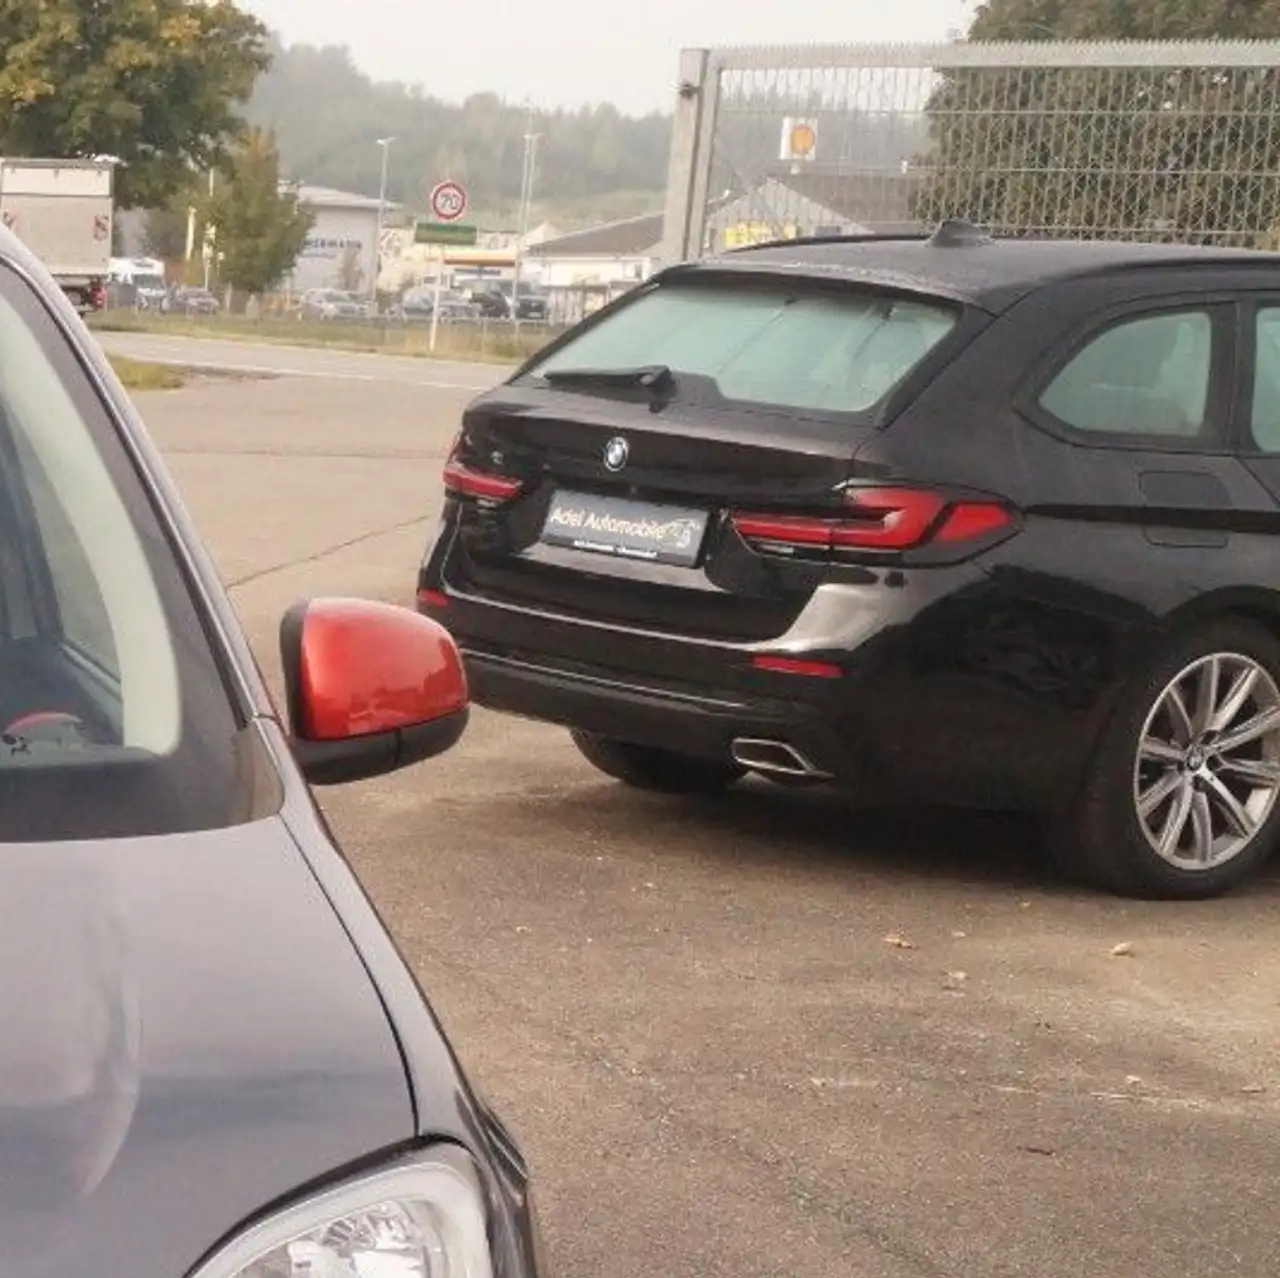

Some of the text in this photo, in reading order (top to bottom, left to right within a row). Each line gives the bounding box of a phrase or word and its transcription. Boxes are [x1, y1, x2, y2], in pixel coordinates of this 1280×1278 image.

[440, 191, 461, 210] 70
[551, 507, 666, 540] Adel Automobile
